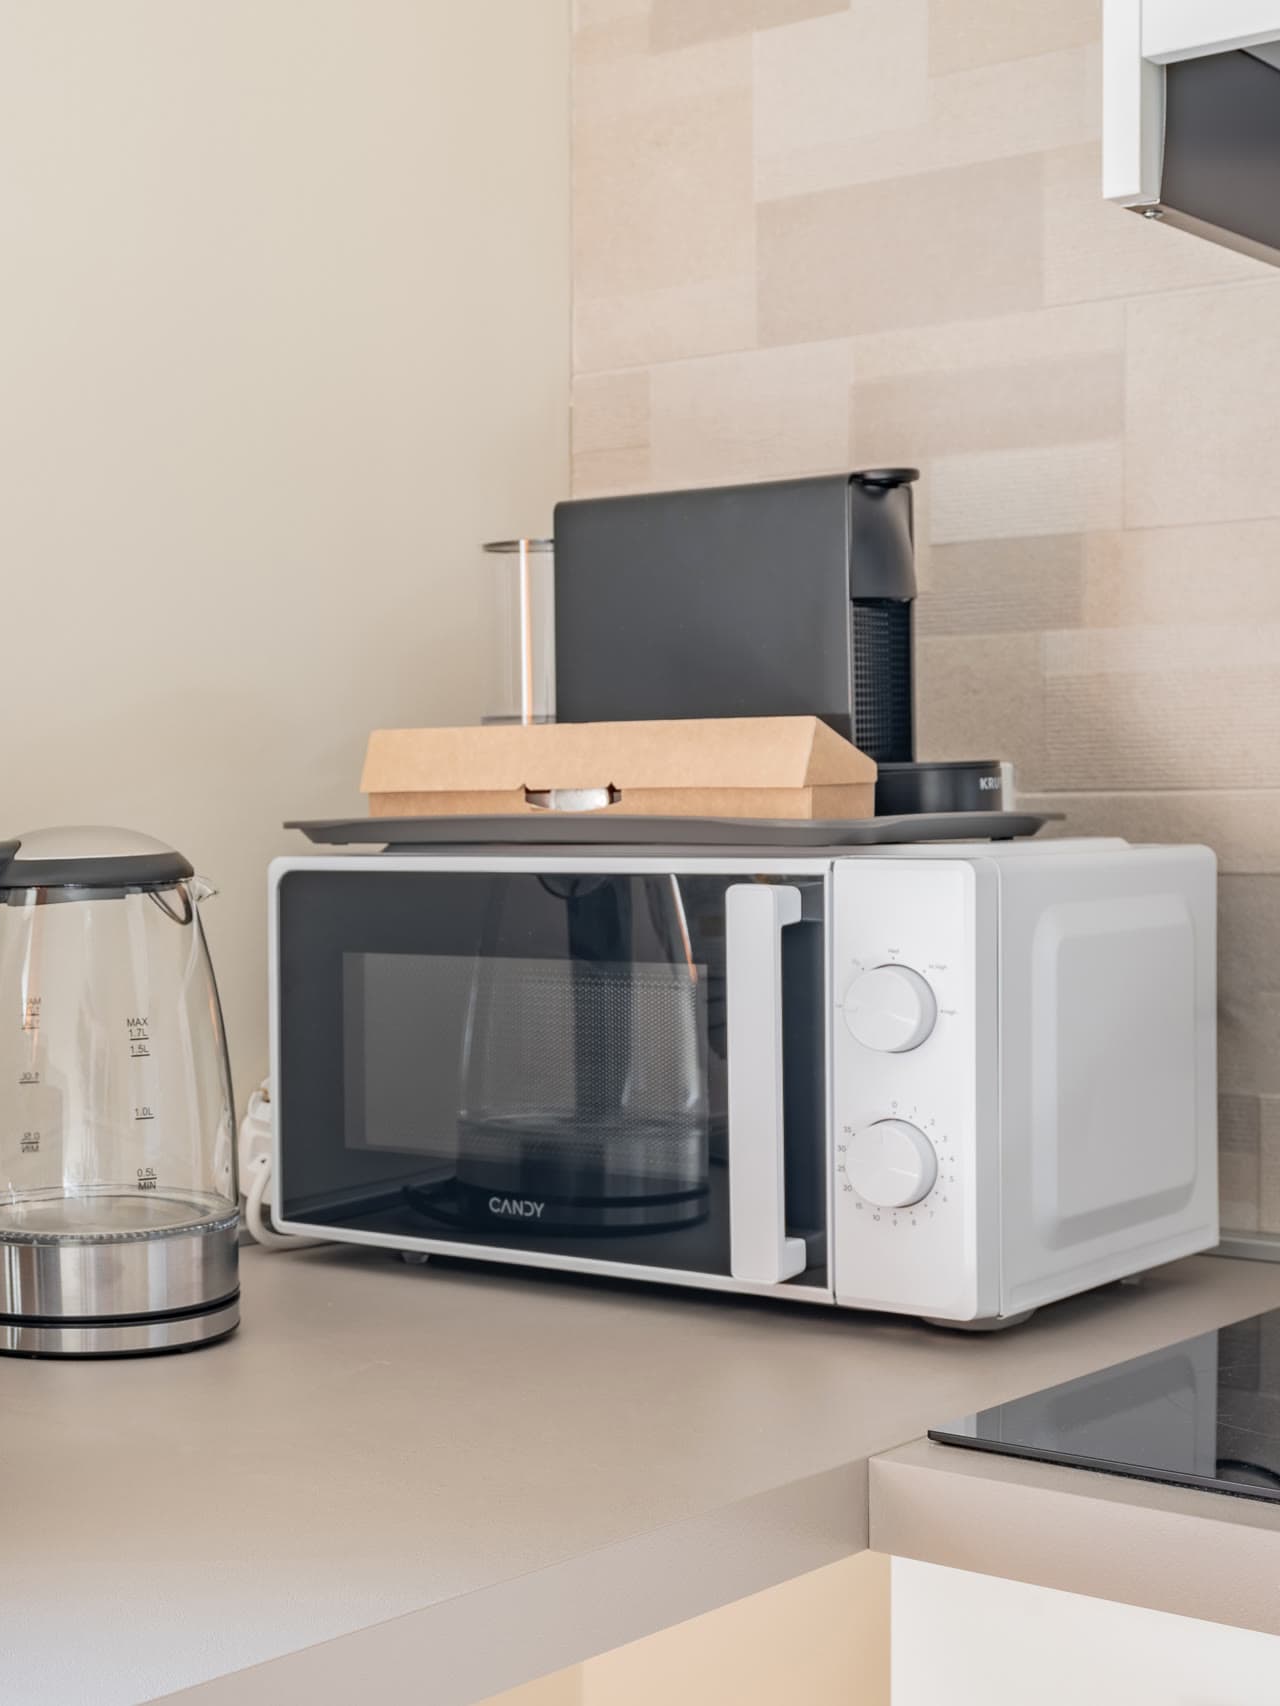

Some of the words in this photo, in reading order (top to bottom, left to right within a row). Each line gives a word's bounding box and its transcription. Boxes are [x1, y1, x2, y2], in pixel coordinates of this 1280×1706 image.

[979, 777, 1000, 791] KRU
[127, 1017, 149, 1027] MAX
[129, 1028, 149, 1037] 1.7L
[130, 1044, 150, 1054] 1.5L
[135, 1107, 154, 1116] 1.0L
[137, 1168, 156, 1177] 0.5L
[138, 1181, 156, 1190] MIN
[488, 1197, 545, 1218] CANDY
